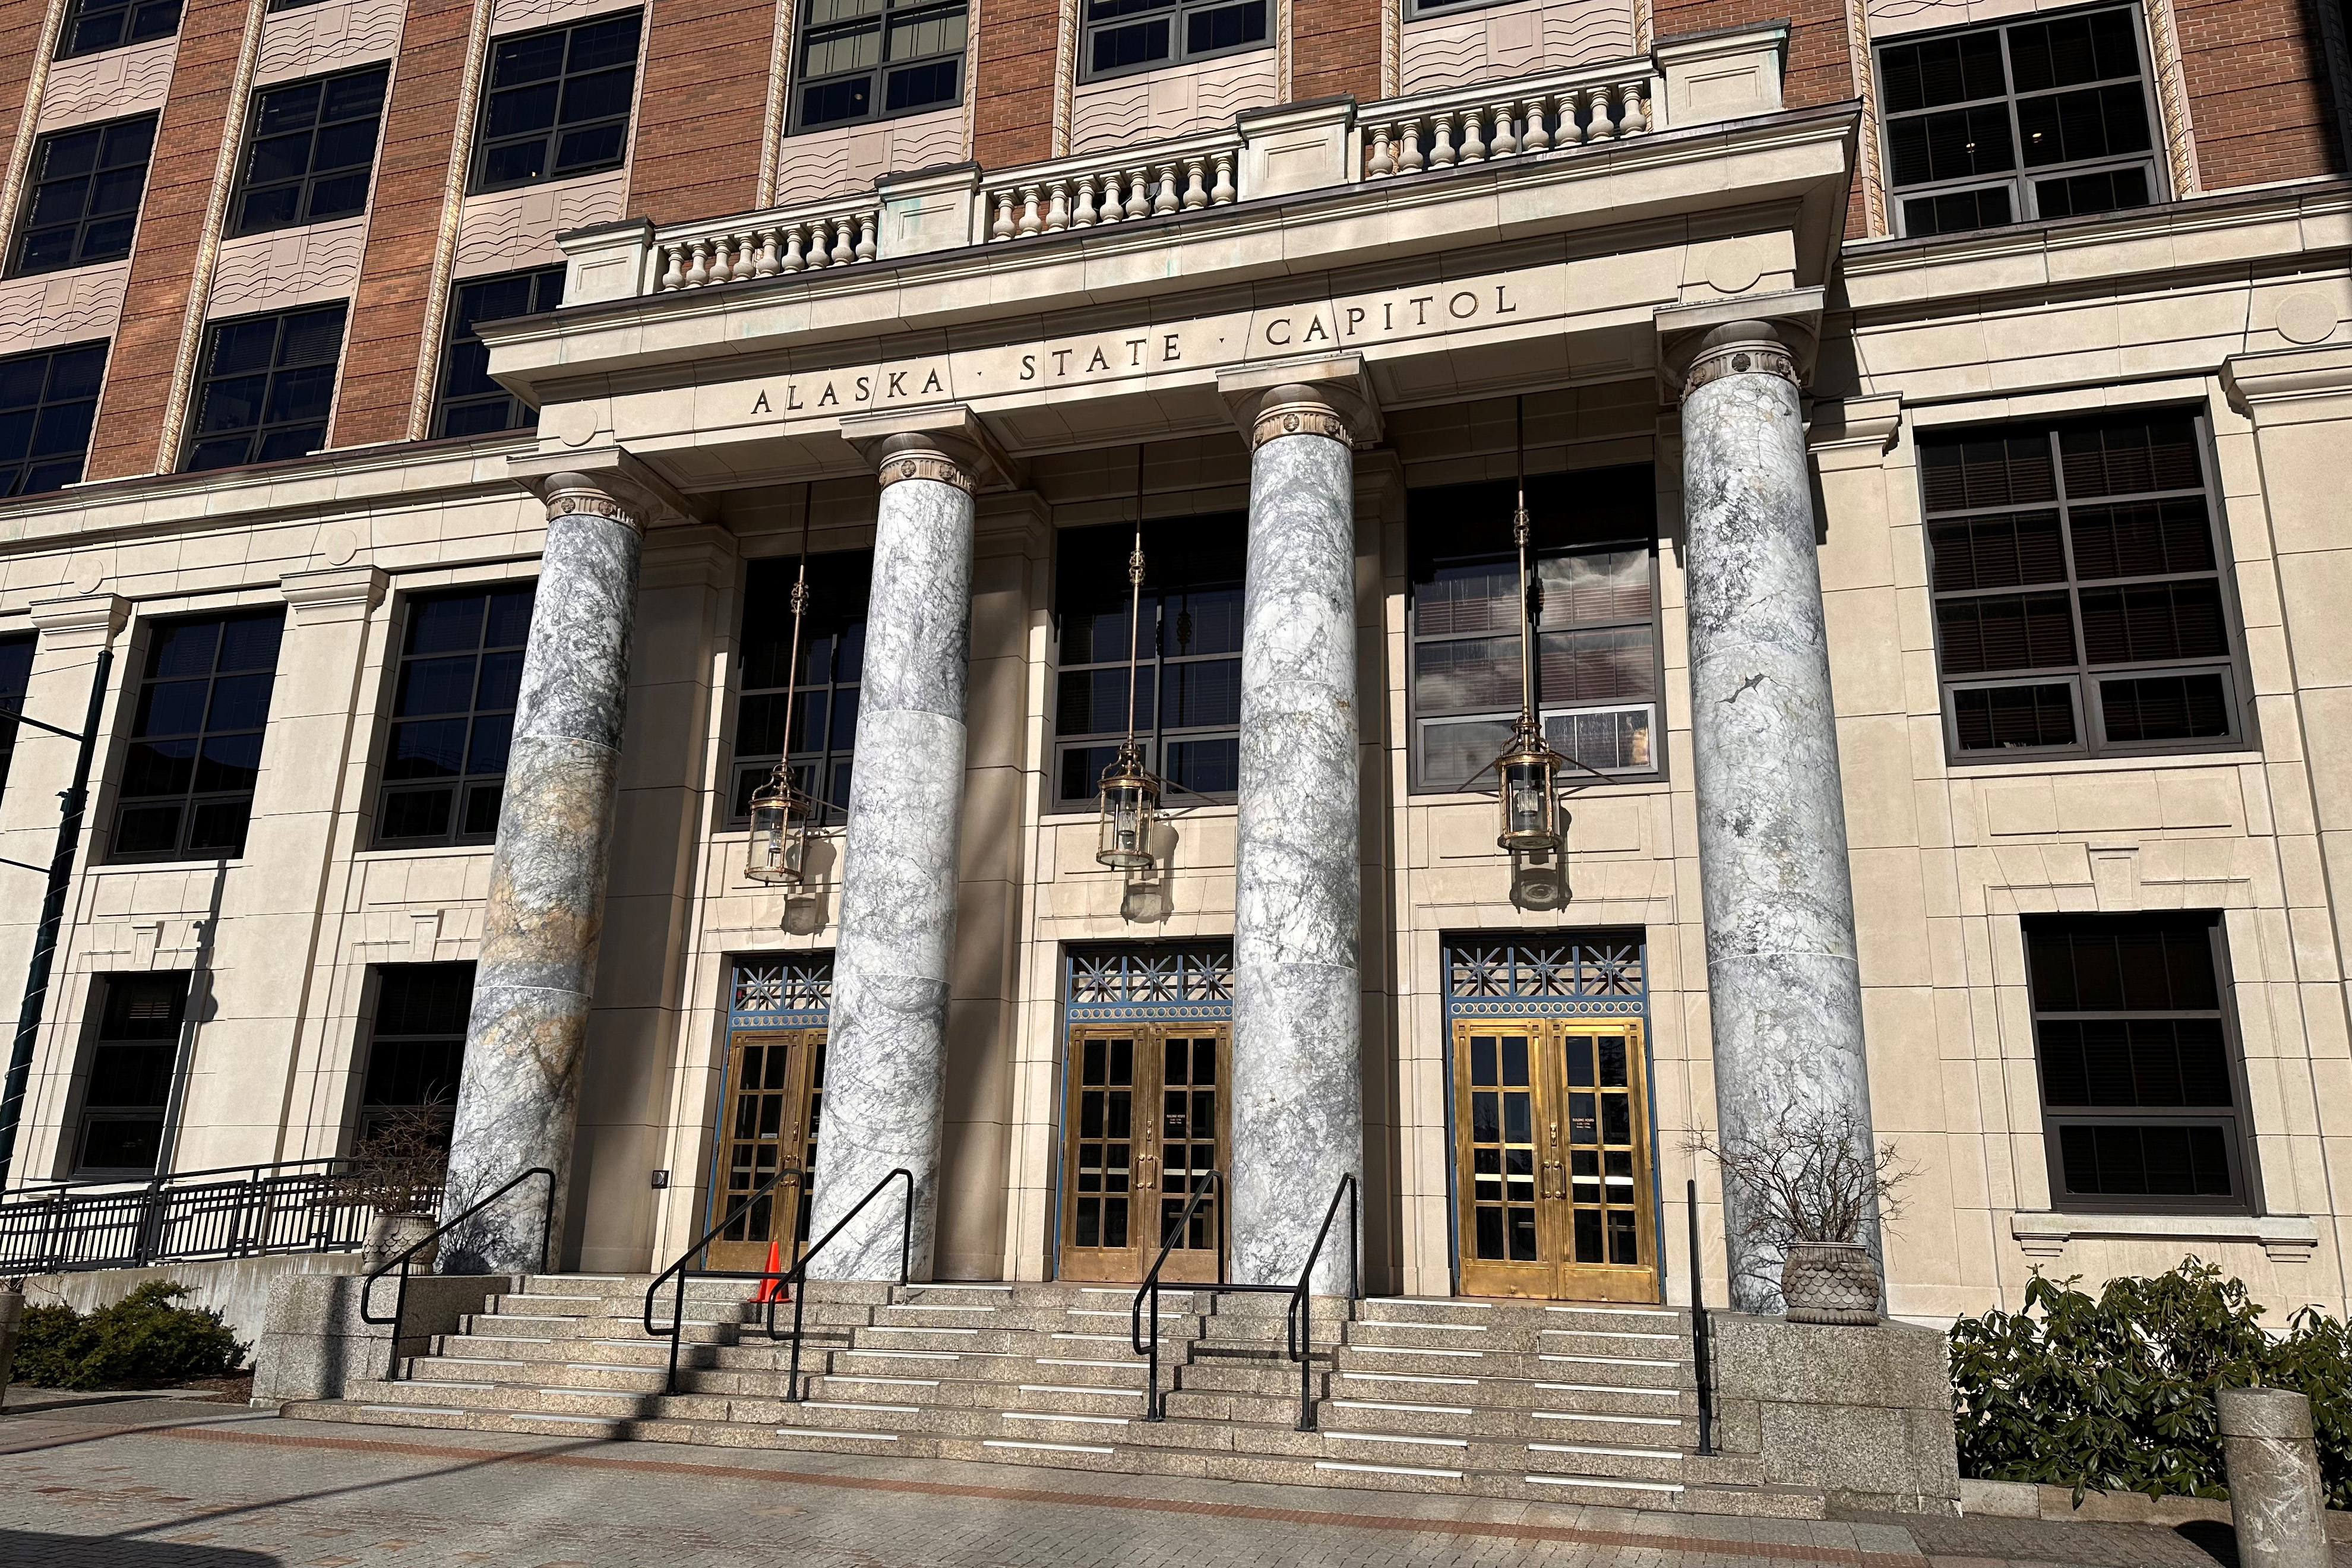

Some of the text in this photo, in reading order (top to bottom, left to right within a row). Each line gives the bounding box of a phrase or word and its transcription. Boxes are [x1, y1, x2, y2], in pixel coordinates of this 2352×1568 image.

[750, 285, 1516, 414] ALASKA STATE CAPITOL
